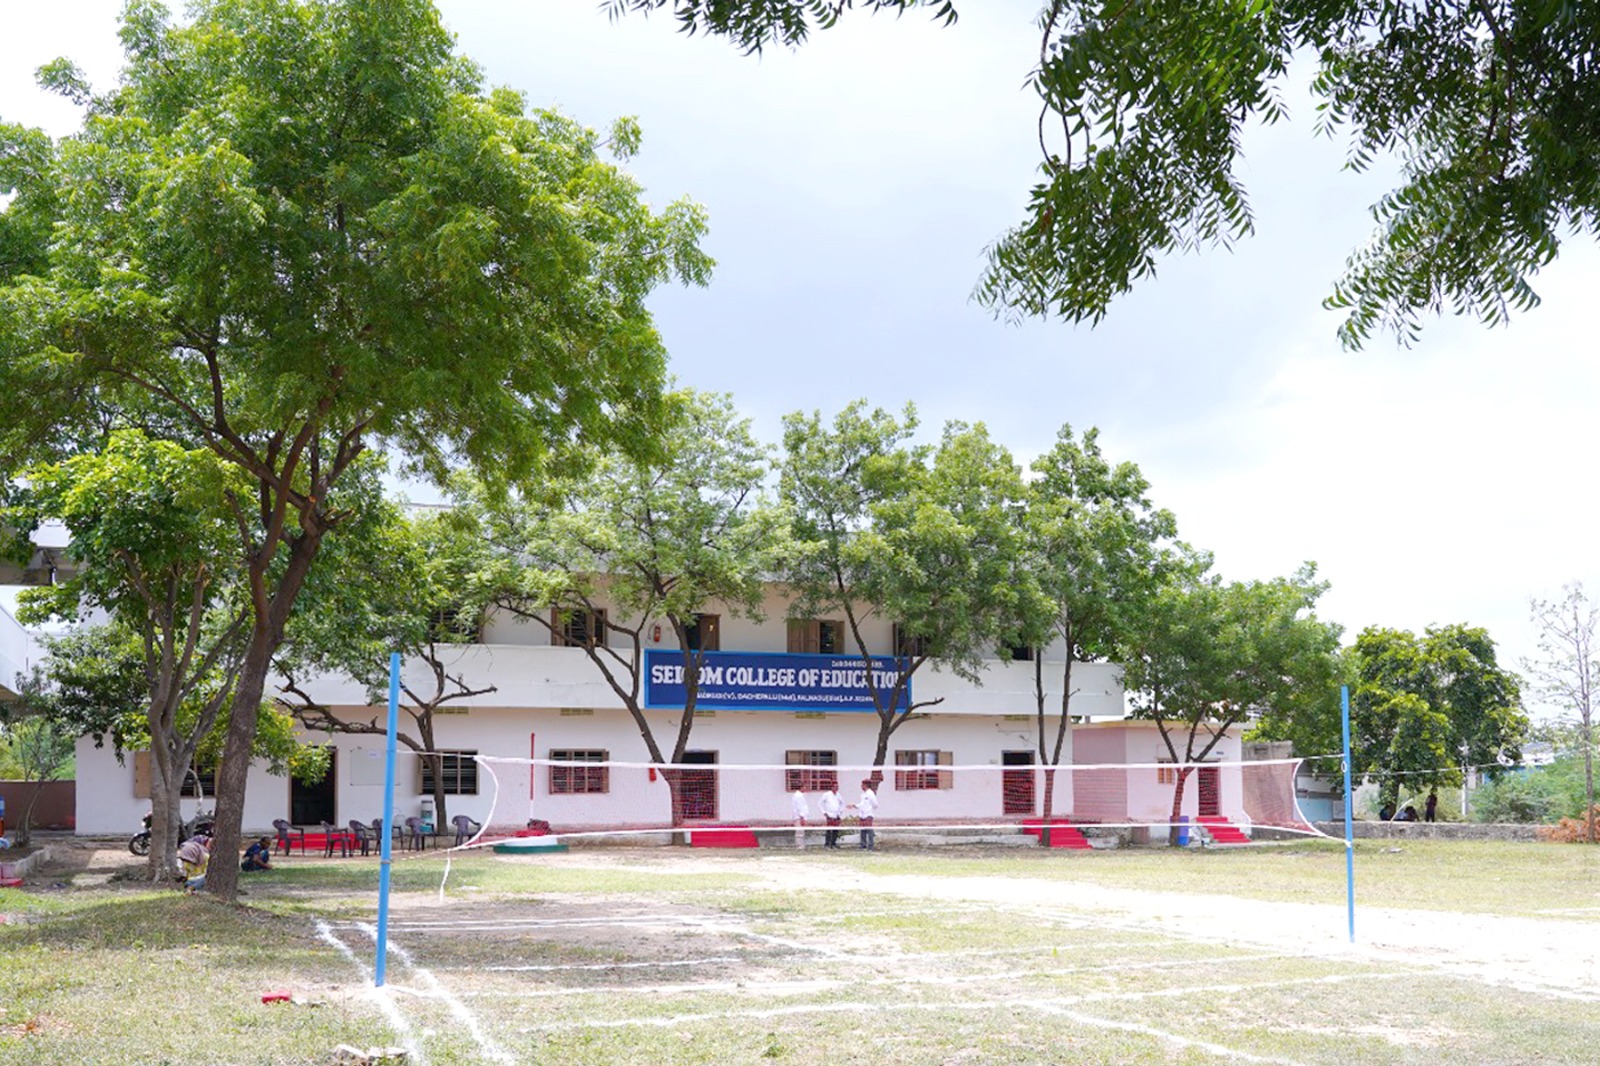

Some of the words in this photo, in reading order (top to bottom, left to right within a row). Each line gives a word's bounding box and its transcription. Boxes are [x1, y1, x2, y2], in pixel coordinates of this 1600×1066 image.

[652, 665, 723, 686] SEIOM
[726, 666, 796, 687] COLLEGE
[798, 668, 819, 687] OF
